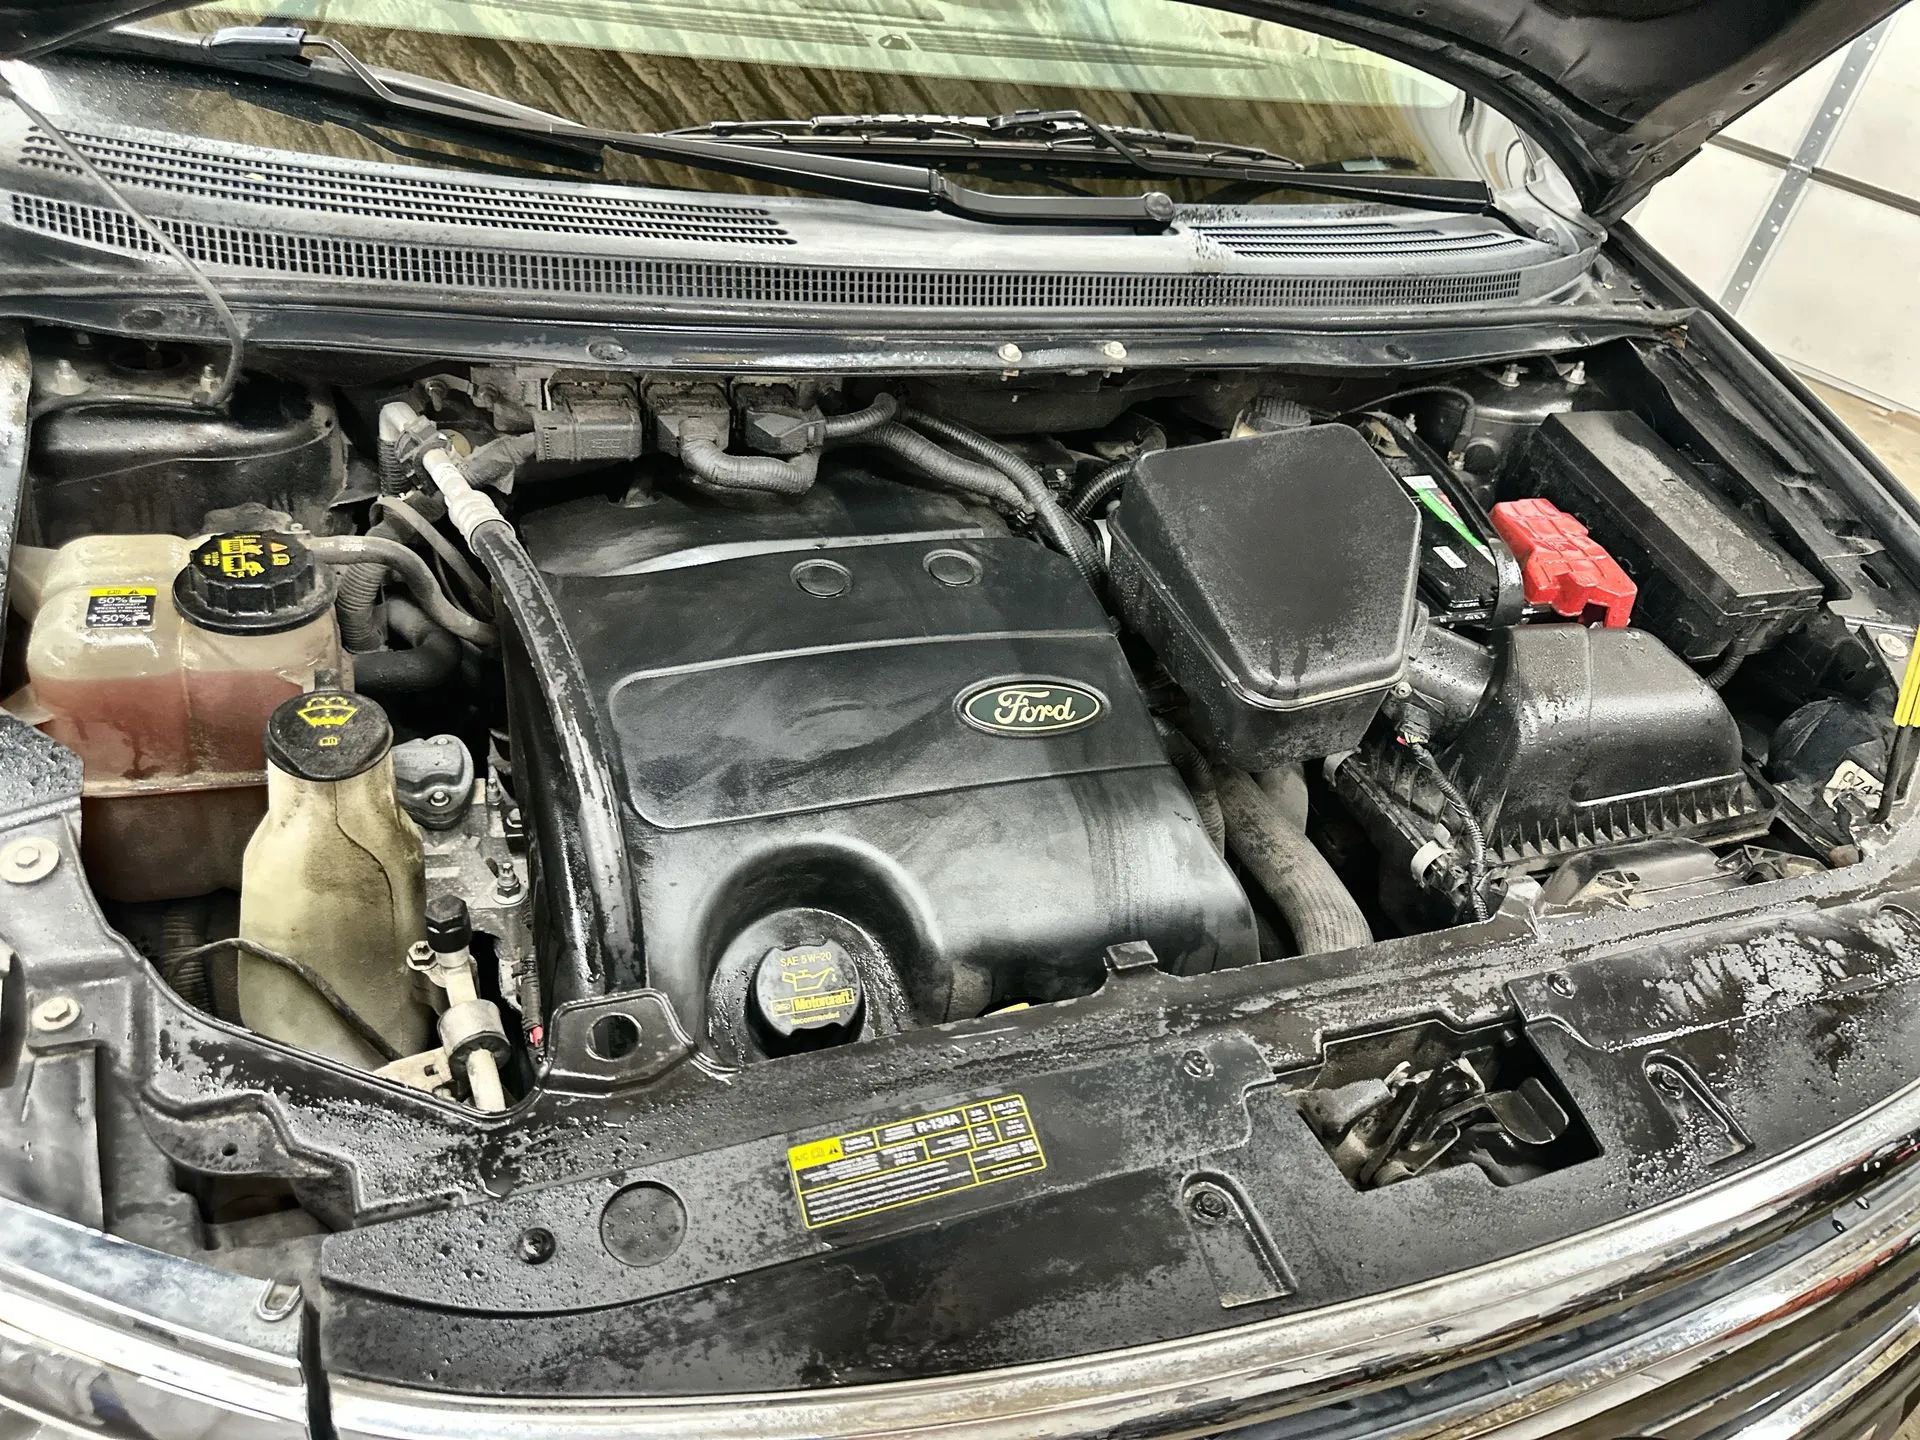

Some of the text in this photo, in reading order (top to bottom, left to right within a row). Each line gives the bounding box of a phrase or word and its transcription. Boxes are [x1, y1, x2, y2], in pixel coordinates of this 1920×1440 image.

[994, 690, 1076, 724] Ford
[780, 951, 832, 967] SAE 5W-20
[794, 990, 852, 1011] Motorcraft
[915, 1113, 961, 1134] R-134A
